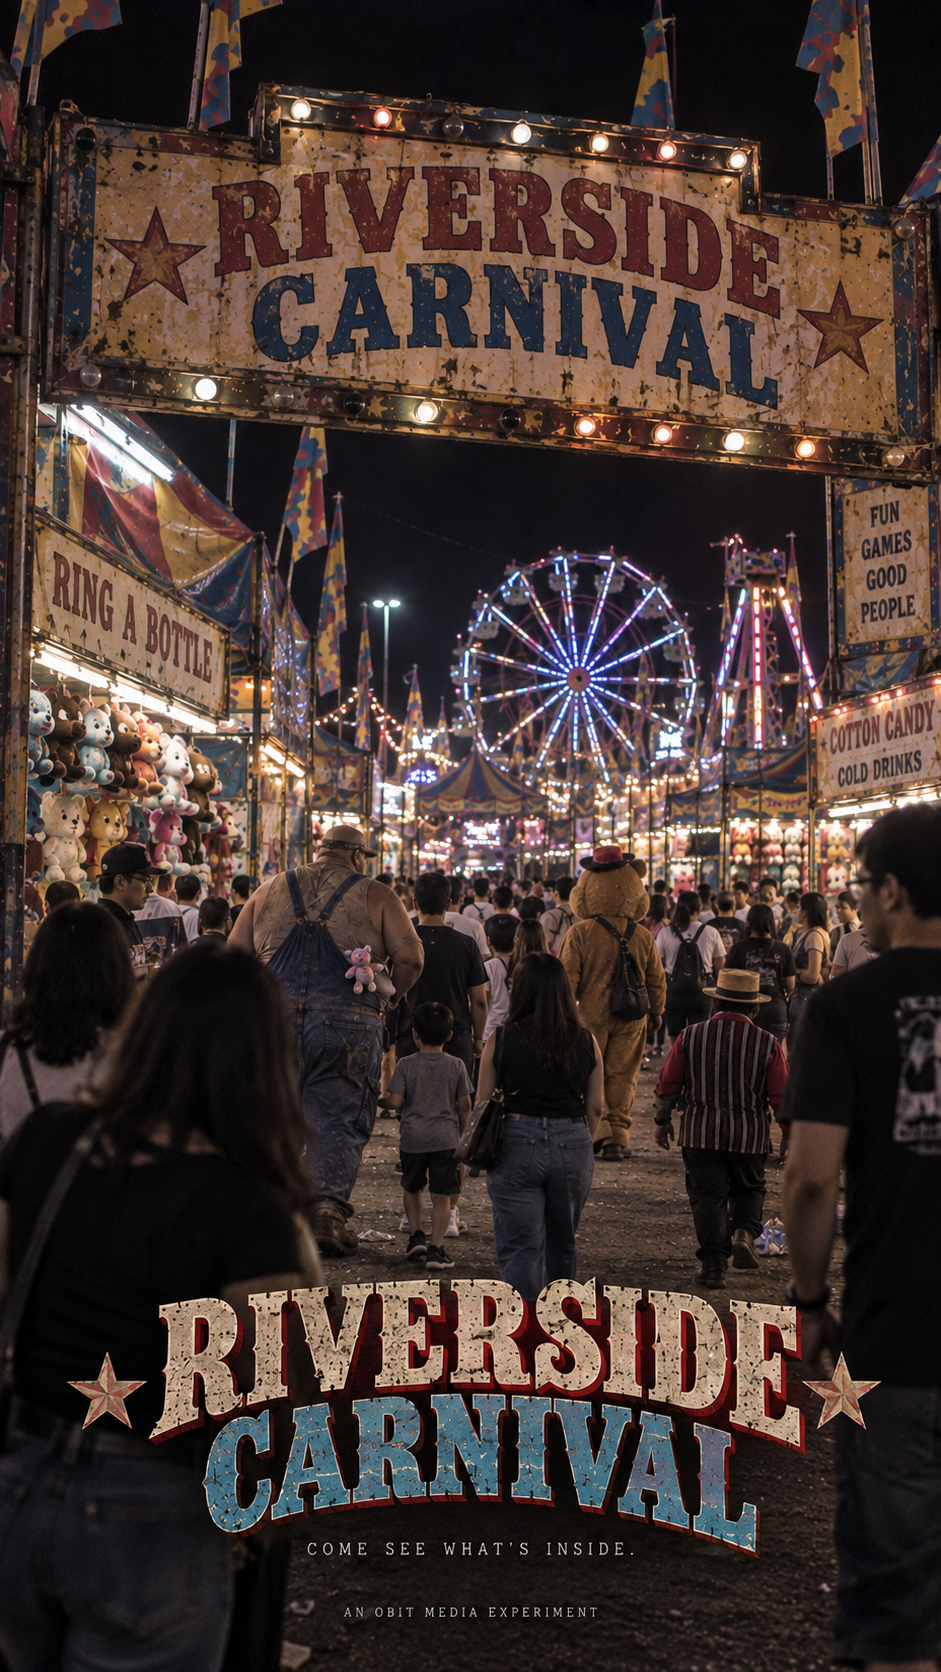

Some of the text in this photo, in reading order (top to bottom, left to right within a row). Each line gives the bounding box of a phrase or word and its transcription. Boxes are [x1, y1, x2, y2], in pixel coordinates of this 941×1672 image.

[212, 166, 782, 319] RIVERSIDE
[252, 263, 779, 409] CARNIVAL
[869, 500, 900, 528] FUN
[861, 529, 912, 561] GAMES
[866, 563, 907, 591] GOOD
[52, 551, 213, 683] RING A BOTTLE
[860, 594, 916, 624] PEOPLE
[829, 699, 935, 756] COTTON CANDY
[837, 750, 922, 789] COLD DRINKS
